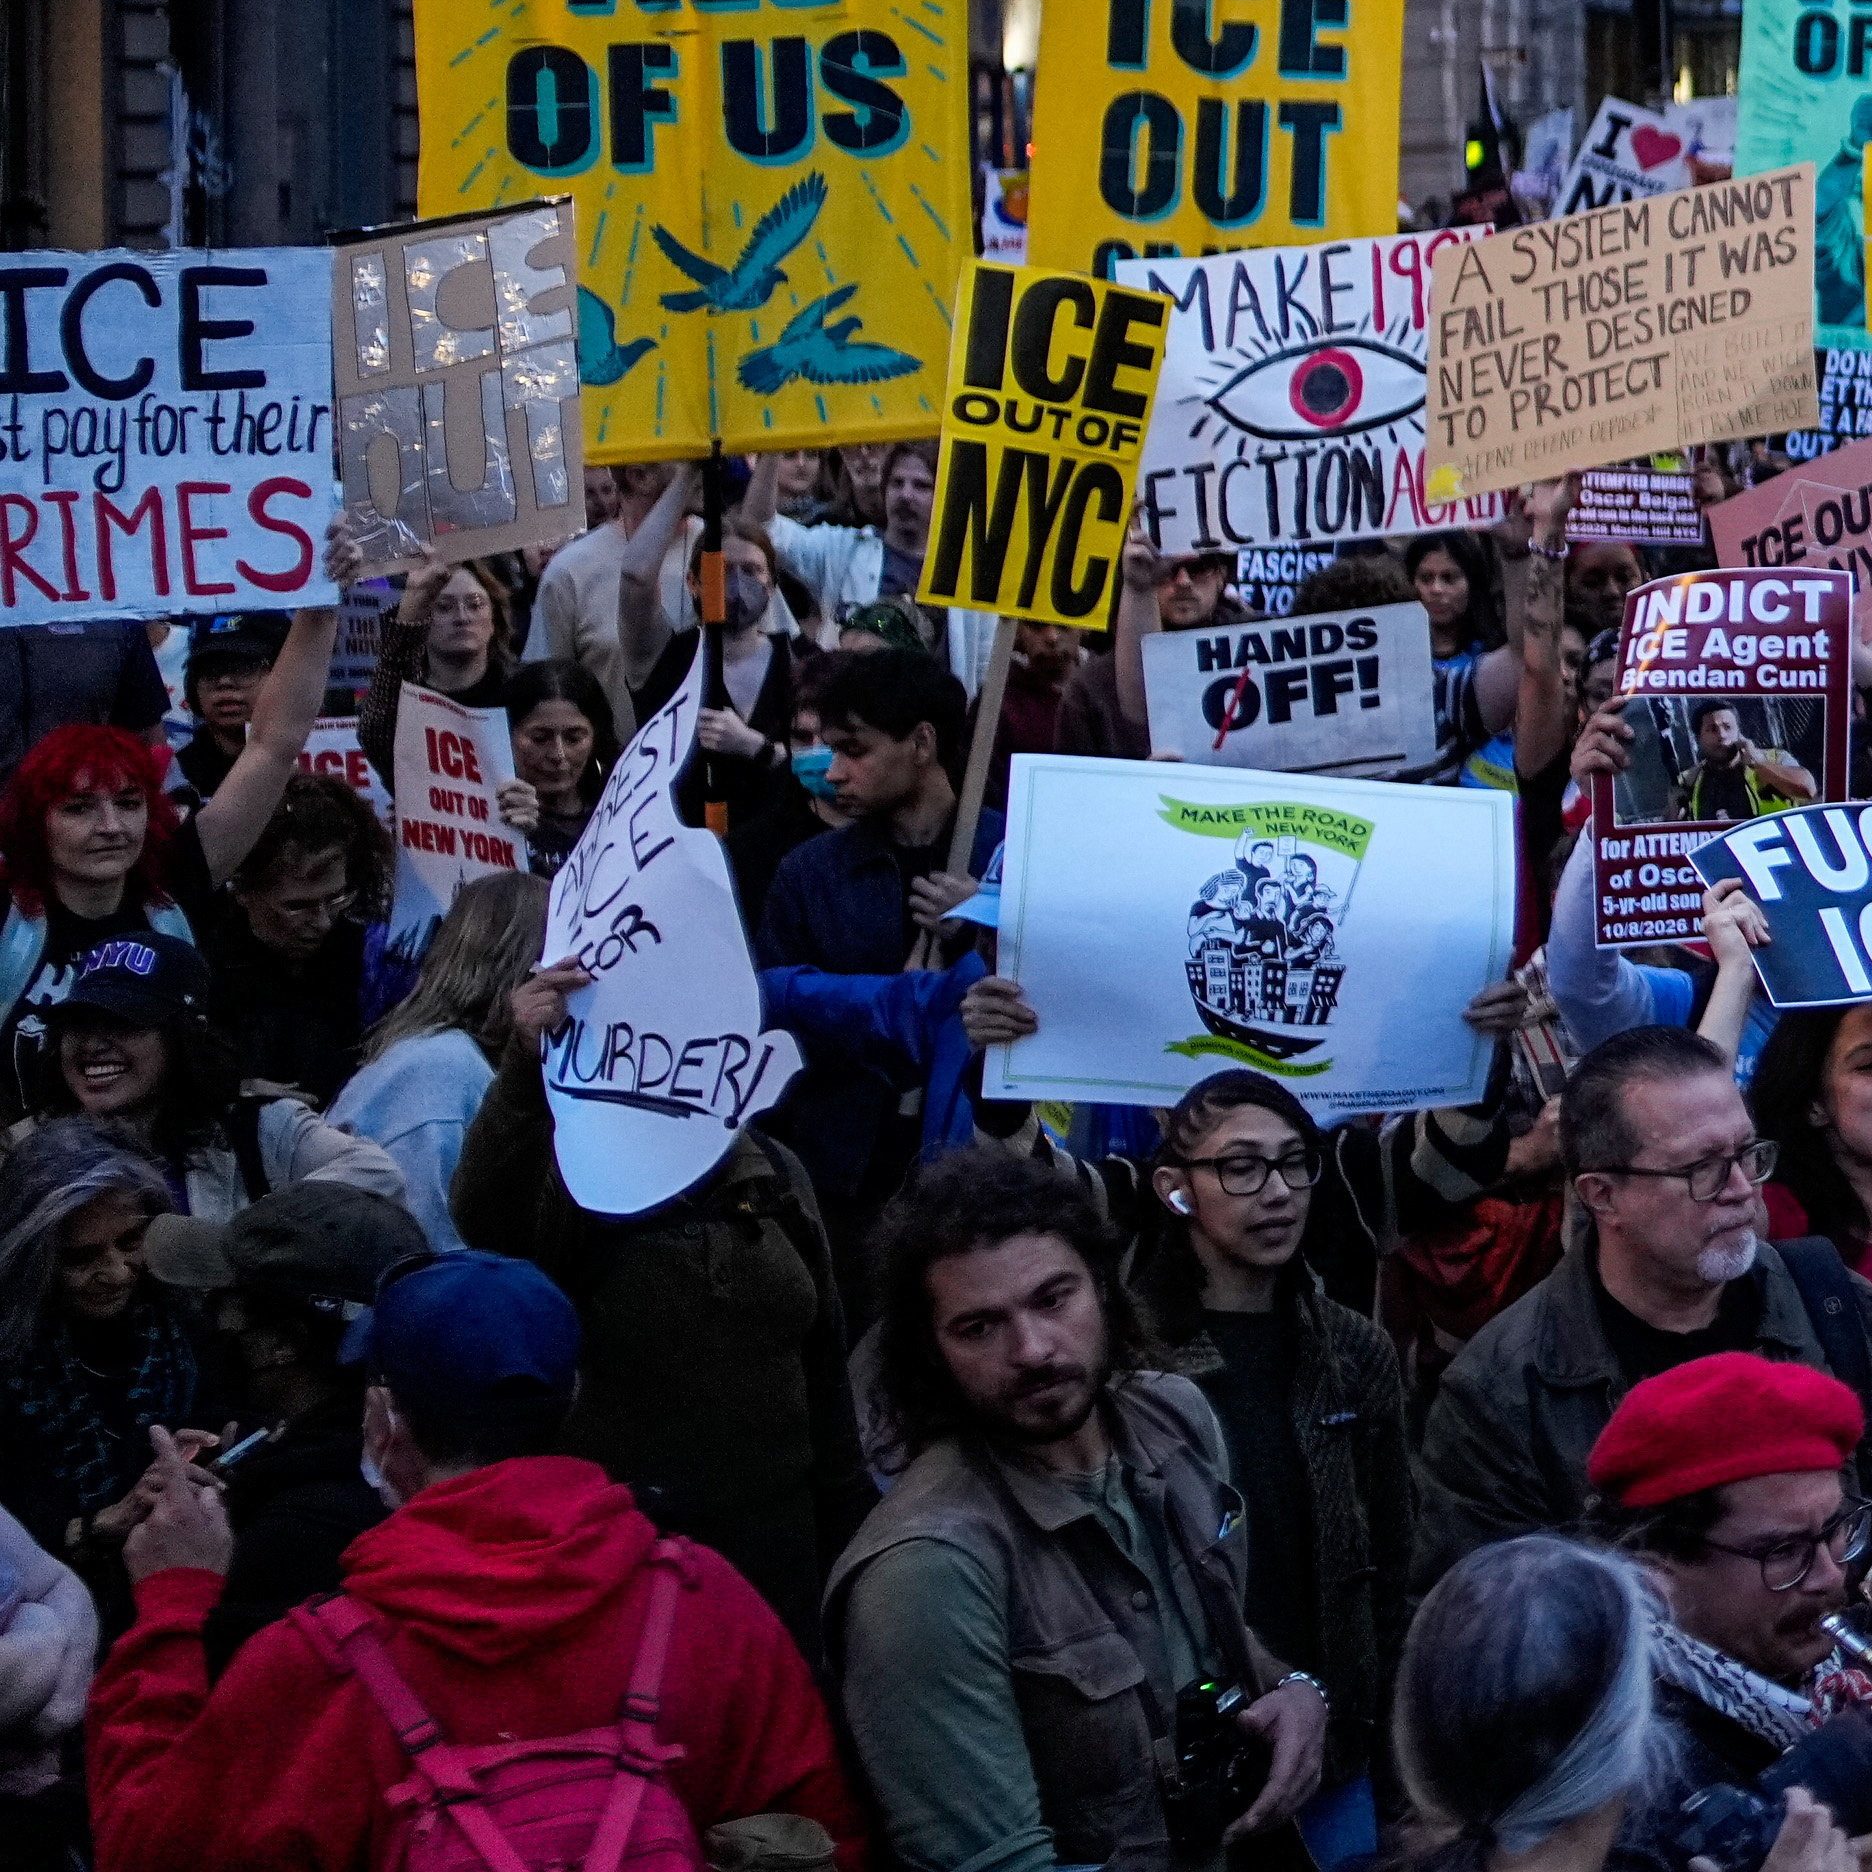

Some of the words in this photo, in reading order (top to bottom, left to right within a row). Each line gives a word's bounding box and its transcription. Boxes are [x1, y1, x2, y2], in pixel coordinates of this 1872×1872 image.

[505, 44, 679, 175] OF
[724, 28, 912, 167] US
[1098, 89, 1343, 228] OUT
[1591, 111, 1632, 159] I
[1450, 245, 1494, 302] A
[1510, 204, 1650, 283] SYSTEM
[1667, 172, 1801, 239] CANNOT
[350, 210, 568, 377] ICE
[1147, 245, 1357, 352] MAKE
[1440, 297, 1524, 357] FAIL
[1532, 258, 1648, 323] THOSE
[1665, 248, 1705, 293] IT
[1718, 227, 1798, 278] WAS
[0, 262, 268, 399] ICE
[964, 269, 1167, 418] ICE
[1439, 333, 1568, 407] NEVER
[1587, 288, 1752, 358] DESIGNED
[1821, 377, 1850, 403] ET
[1825, 349, 1855, 376] DO
[953, 393, 1076, 444] OUT
[1081, 410, 1142, 450] OF
[1437, 407, 1487, 445] TO
[1509, 353, 1672, 430] PROTECT
[41, 401, 129, 494] pay
[134, 394, 206, 458] for
[209, 391, 330, 456] their
[342, 339, 580, 567] OUT
[1785, 431, 1836, 458] OUT
[1144, 446, 1385, 550] FICTION
[0, 477, 316, 604] RIMES
[930, 440, 1125, 619] NYC
[1741, 517, 1806, 570] ICE
[1236, 547, 1334, 583] FASCIST
[1631, 578, 1834, 635] INDICT
[1195, 616, 1379, 672] HANDS
[1626, 629, 1689, 663] ICE
[1700, 629, 1830, 666] Agent
[1201, 654, 1381, 732] OFF!
[1620, 666, 1747, 691] Brendan
[1756, 664, 1828, 690] Cuni
[425, 727, 483, 784] ICE
[428, 786, 464, 814] OUT
[468, 795, 489, 822] OF
[1181, 807, 1247, 823] MAKE
[1249, 806, 1296, 821] THE
[1303, 809, 1367, 836] ROAD
[401, 819, 456, 856] NEW
[461, 830, 516, 869] YORK
[1266, 822, 1310, 835] NEW
[1315, 828, 1360, 851] YORK
[1600, 837, 1631, 860] for
[1603, 892, 1667, 916] 5-yr-old
[1670, 893, 1701, 910] son
[1610, 869, 1633, 890] of
[575, 904, 663, 983] FOR
[540, 1014, 775, 1130] MURDER!
